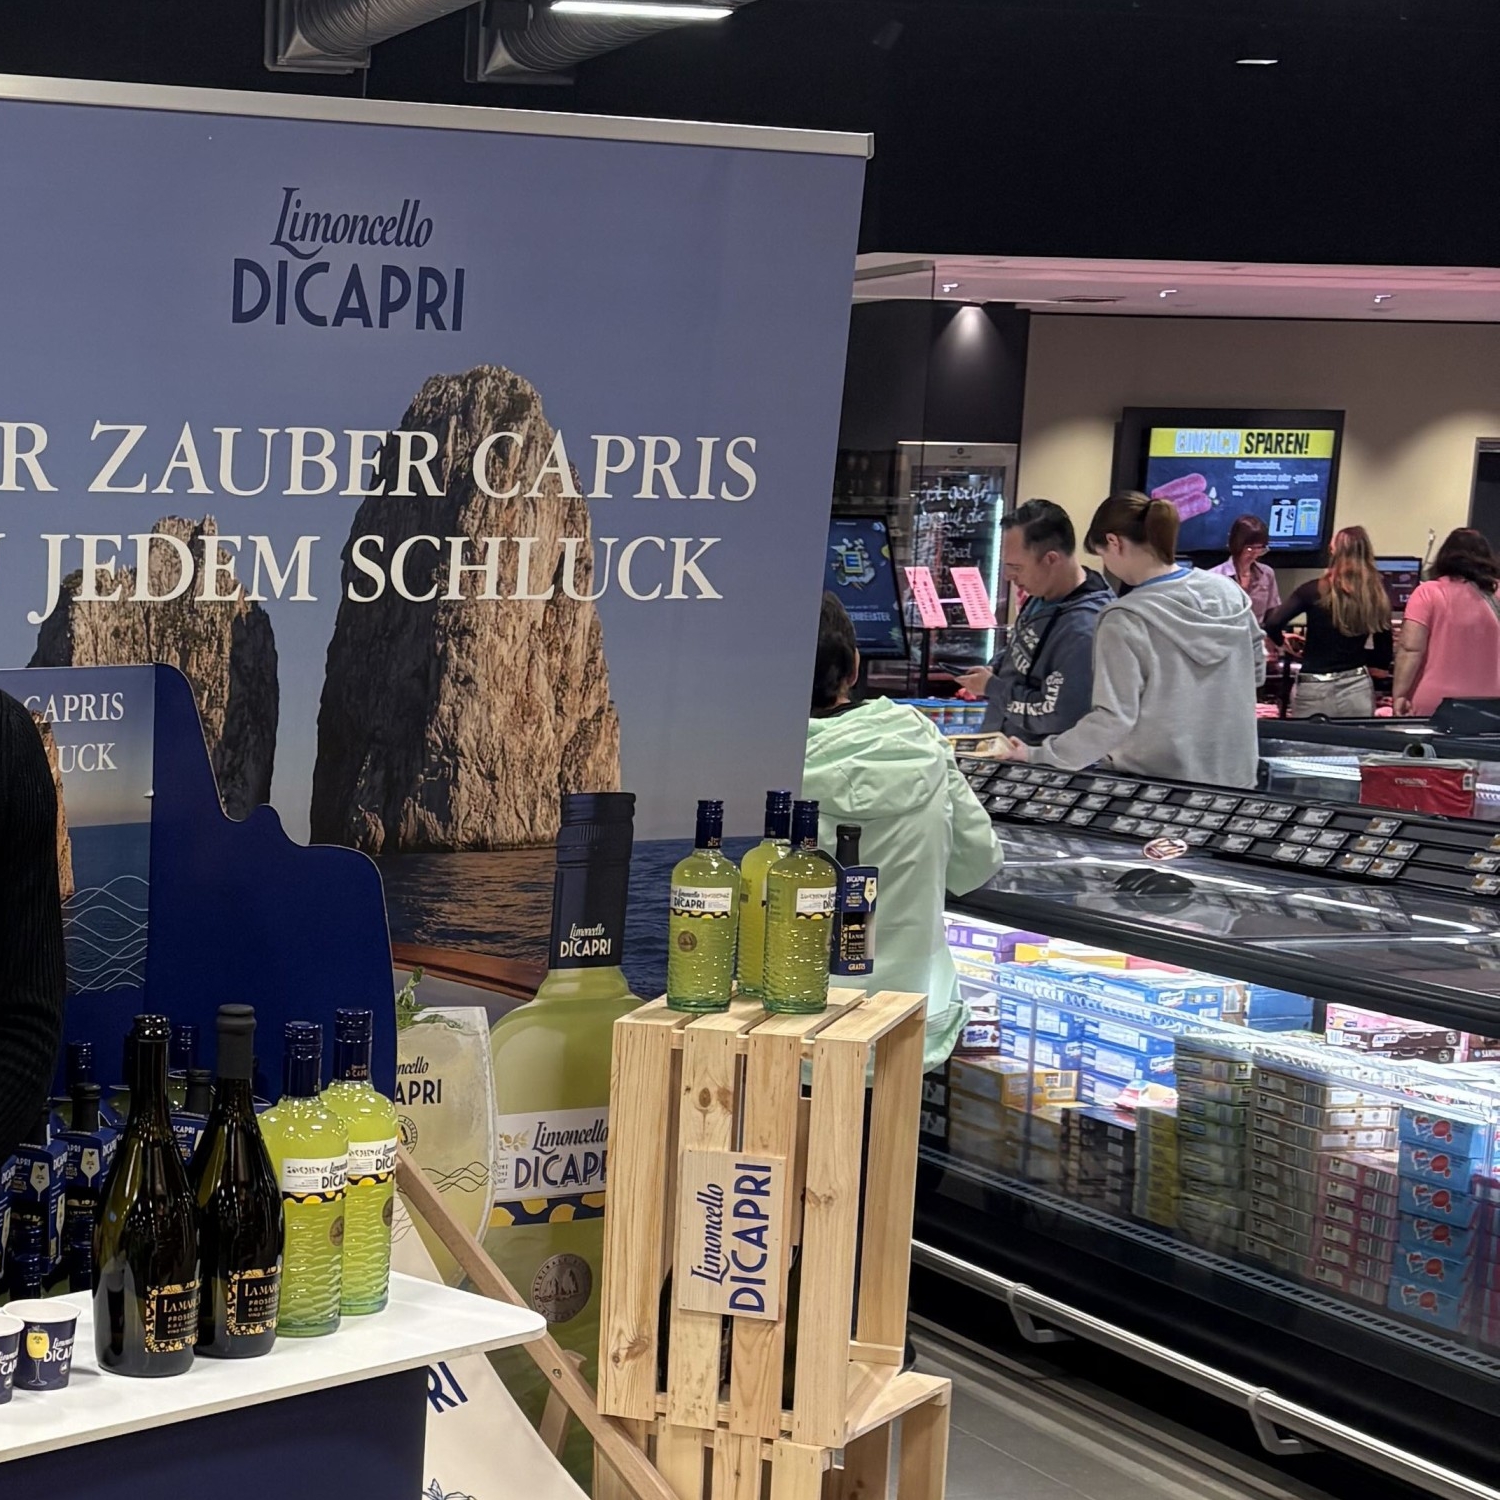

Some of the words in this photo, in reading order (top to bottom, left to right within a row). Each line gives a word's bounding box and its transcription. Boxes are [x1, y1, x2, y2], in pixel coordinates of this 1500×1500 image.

[270, 187, 433, 260] Limoncello
[232, 258, 465, 331] DICAPRI
[88, 419, 447, 498] ZAUBER
[473, 430, 758, 502] CAPRIS
[1244, 432, 1310, 454] SPAREN!
[28, 533, 321, 625] JEDEM
[348, 534, 723, 601] SCHLUCK
[44, 742, 118, 773] UCK
[560, 938, 612, 958] DICAPRI
[532, 1119, 607, 1155] Limoncello
[691, 1183, 731, 1287] Limoncello
[729, 1163, 772, 1313] DICAPRI
